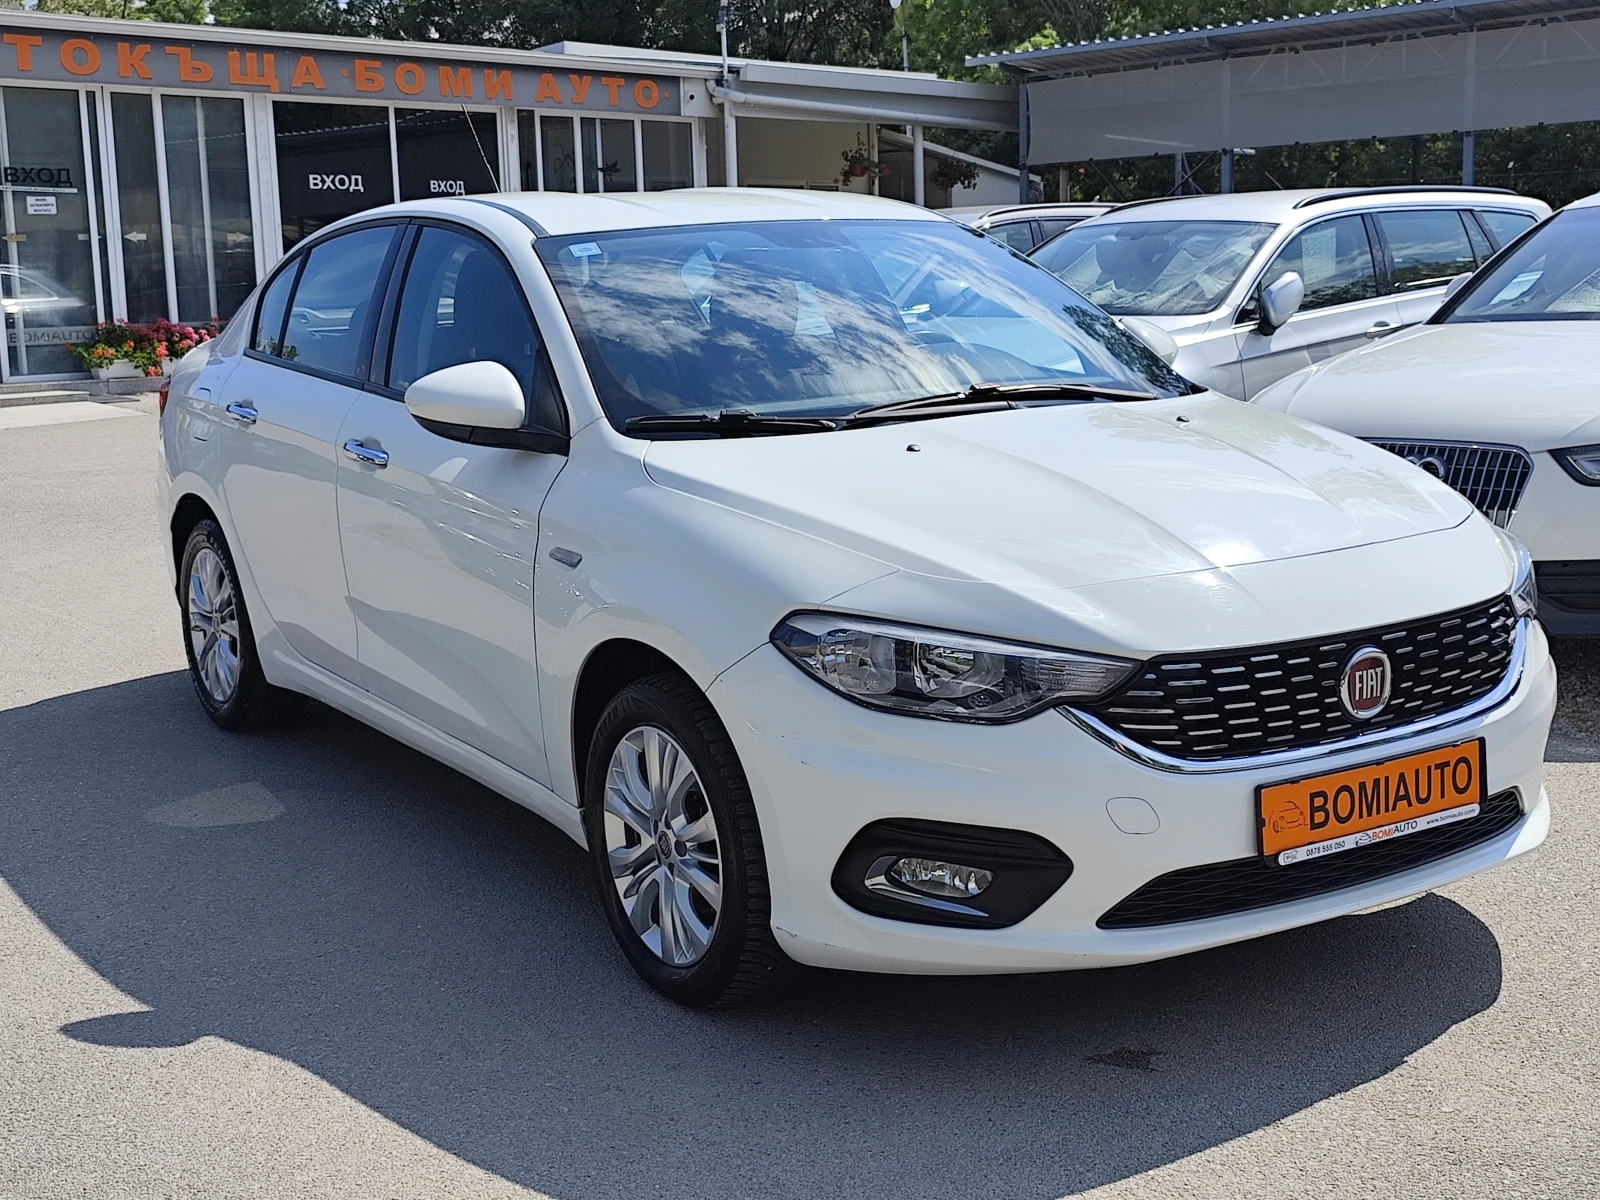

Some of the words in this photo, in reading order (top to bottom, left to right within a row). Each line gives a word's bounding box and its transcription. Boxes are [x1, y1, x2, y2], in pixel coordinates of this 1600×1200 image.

[354, 59, 513, 101] БОМИ
[535, 72, 660, 109] АУТО
[4, 166, 73, 187] ВХОД
[308, 174, 365, 193] ВХОД
[430, 179, 466, 196] ВХОД
[1355, 666, 1383, 701] FIAT
[1309, 756, 1473, 831] BOMIAUTO
[1306, 847, 1321, 857] 0878
[1322, 843, 1334, 853] 555
[1372, 820, 1418, 841] BOMIAUTO
